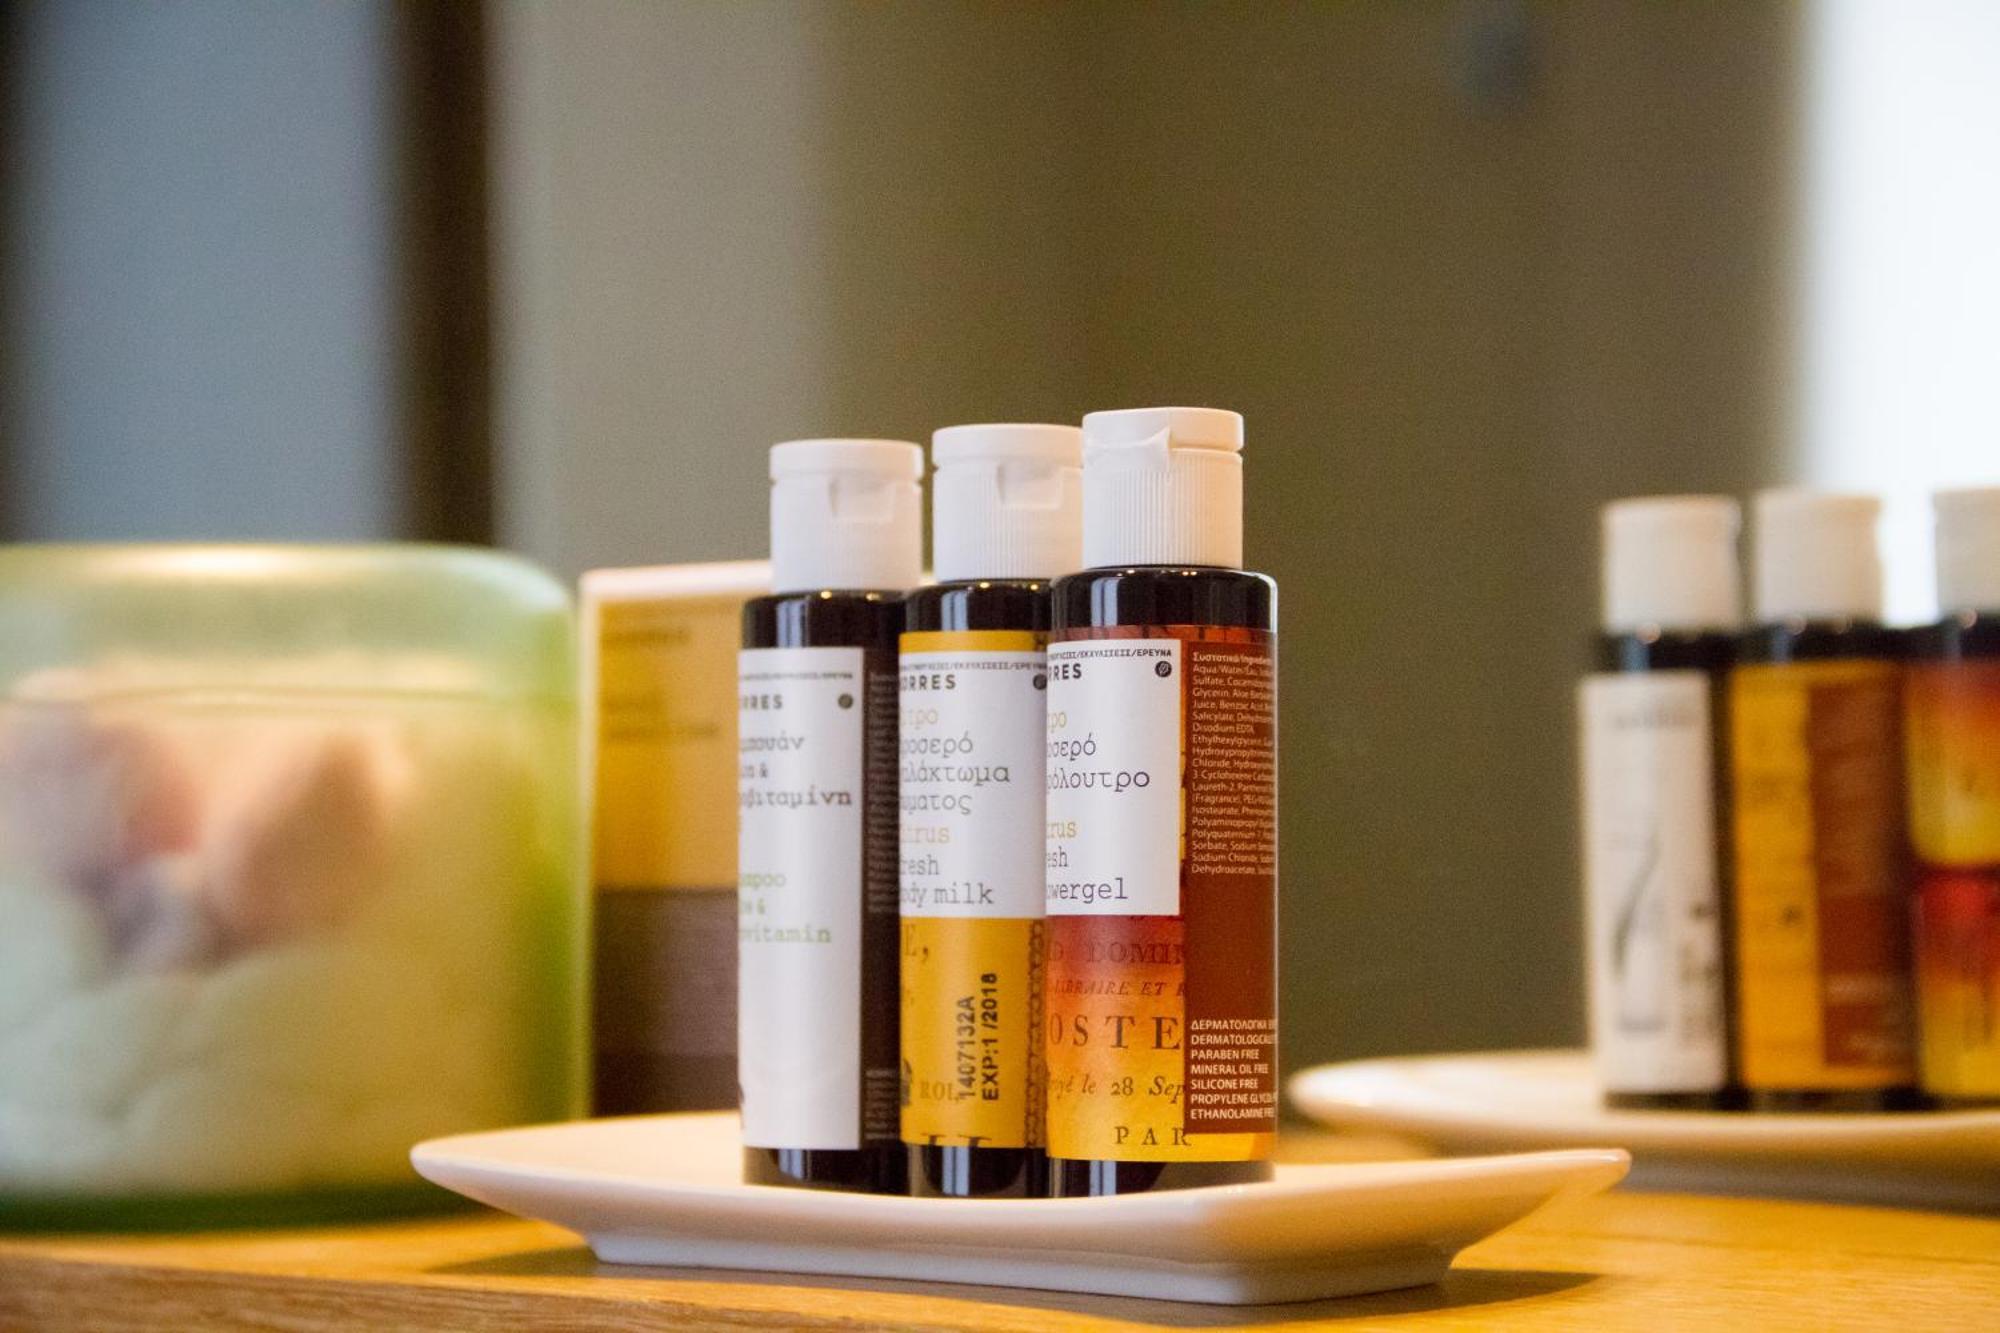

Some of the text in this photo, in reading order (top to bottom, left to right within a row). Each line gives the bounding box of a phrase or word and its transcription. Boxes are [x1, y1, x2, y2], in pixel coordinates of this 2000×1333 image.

[934, 882, 995, 905] milk
[957, 996, 976, 1099] 1407132A
[1191, 1049, 1259, 1059] PARABEN FREE
[1191, 1064, 1268, 1074] MINERAL OIL FREE
[1111, 1076, 1134, 1097] 28
[1191, 1079, 1258, 1089] SILICONE FREE
[1191, 1093, 1248, 1104] PROPYLENE
